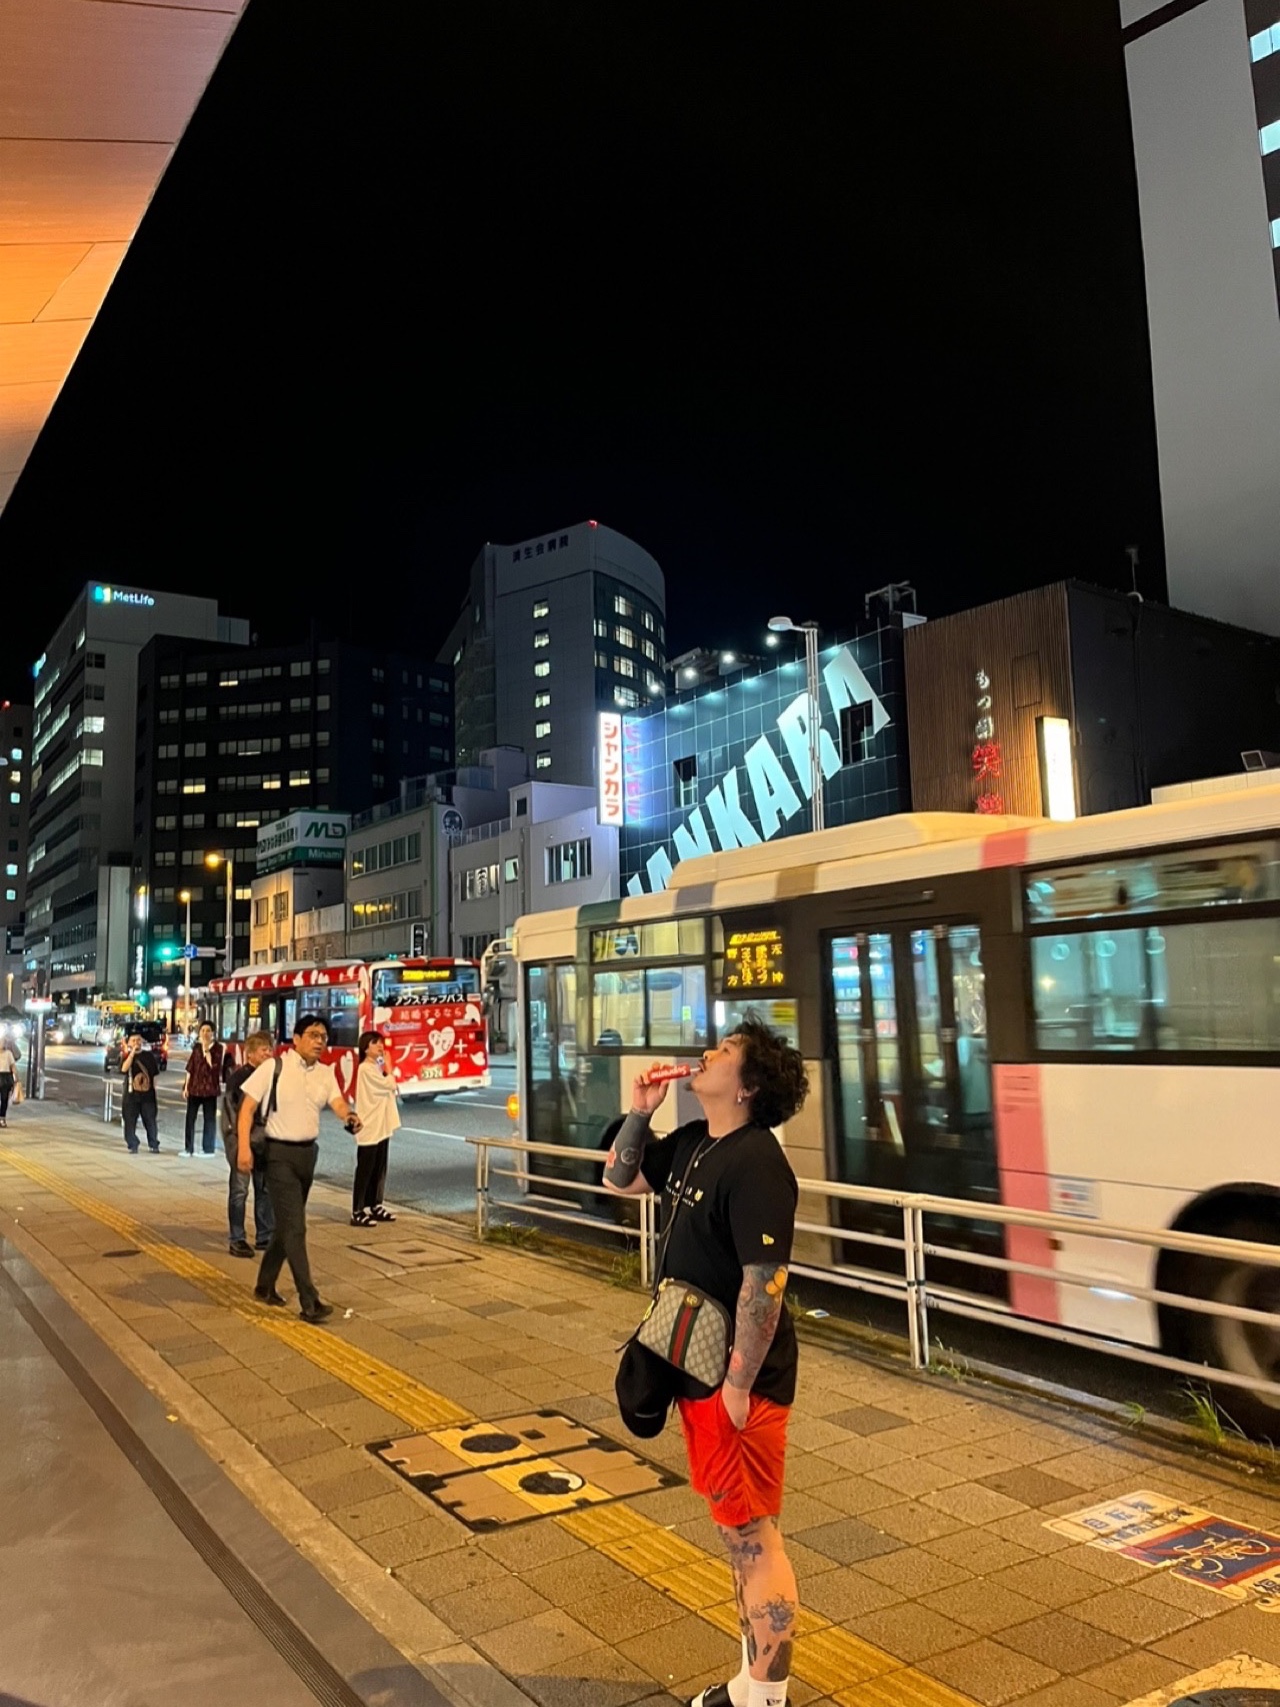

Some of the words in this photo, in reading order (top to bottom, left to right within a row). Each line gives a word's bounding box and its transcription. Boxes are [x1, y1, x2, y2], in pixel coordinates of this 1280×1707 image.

[113, 590, 155, 606] MetLife
[627, 646, 891, 896] ANKARA
[308, 848, 343, 859] Minami
[395, 993, 465, 1006] ノンステップバス
